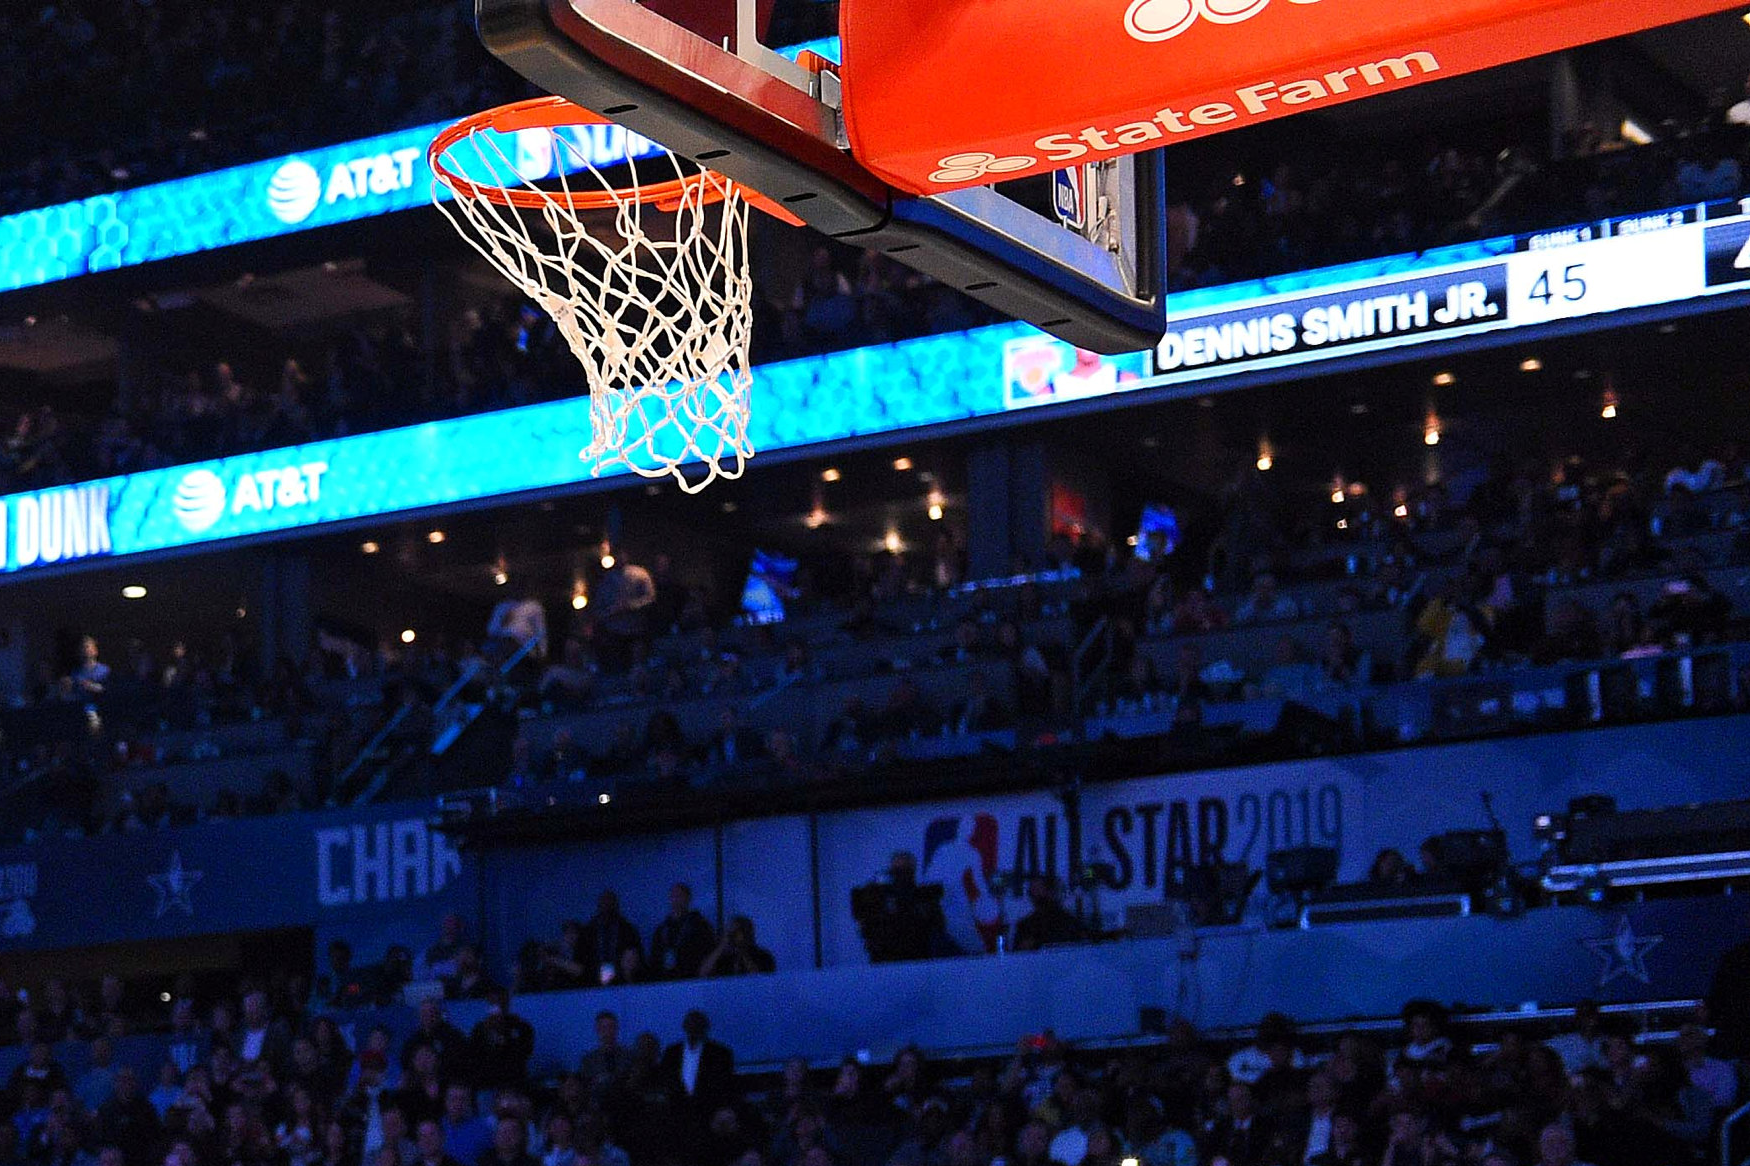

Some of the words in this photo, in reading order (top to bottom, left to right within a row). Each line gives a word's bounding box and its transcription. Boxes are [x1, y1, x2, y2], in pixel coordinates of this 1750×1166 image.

[324, 147, 421, 205] AT&T
[1157, 313, 1296, 371] DENNIS
[1301, 290, 1428, 346] SMITH
[1433, 281, 1499, 324] JR.
[1528, 263, 1587, 305] 45
[230, 462, 328, 515] AT&T
[16, 484, 111, 566] DUNK
